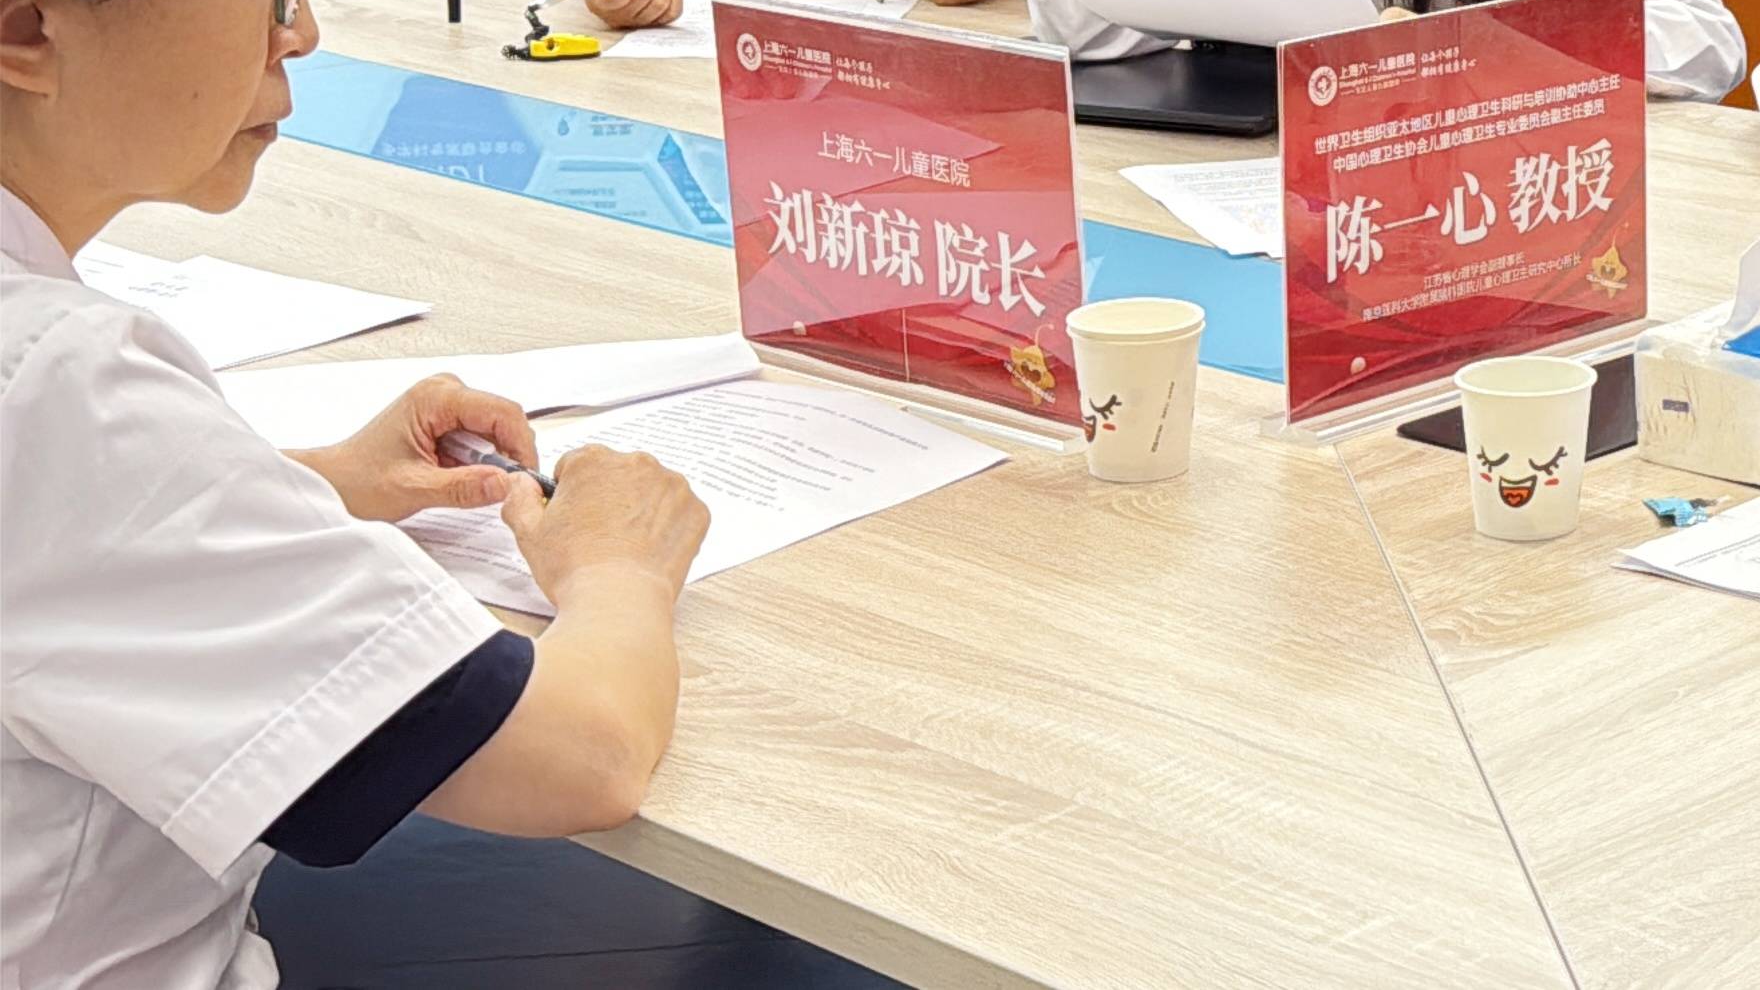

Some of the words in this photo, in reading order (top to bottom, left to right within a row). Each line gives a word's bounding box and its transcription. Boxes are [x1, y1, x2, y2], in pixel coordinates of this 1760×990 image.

[818, 131, 970, 187] 上海六一儿童医院
[1326, 171, 1497, 283] 陈一心
[1508, 138, 1615, 234] 教授
[763, 181, 924, 287] 刘新琼
[934, 218, 1046, 316] 院长
